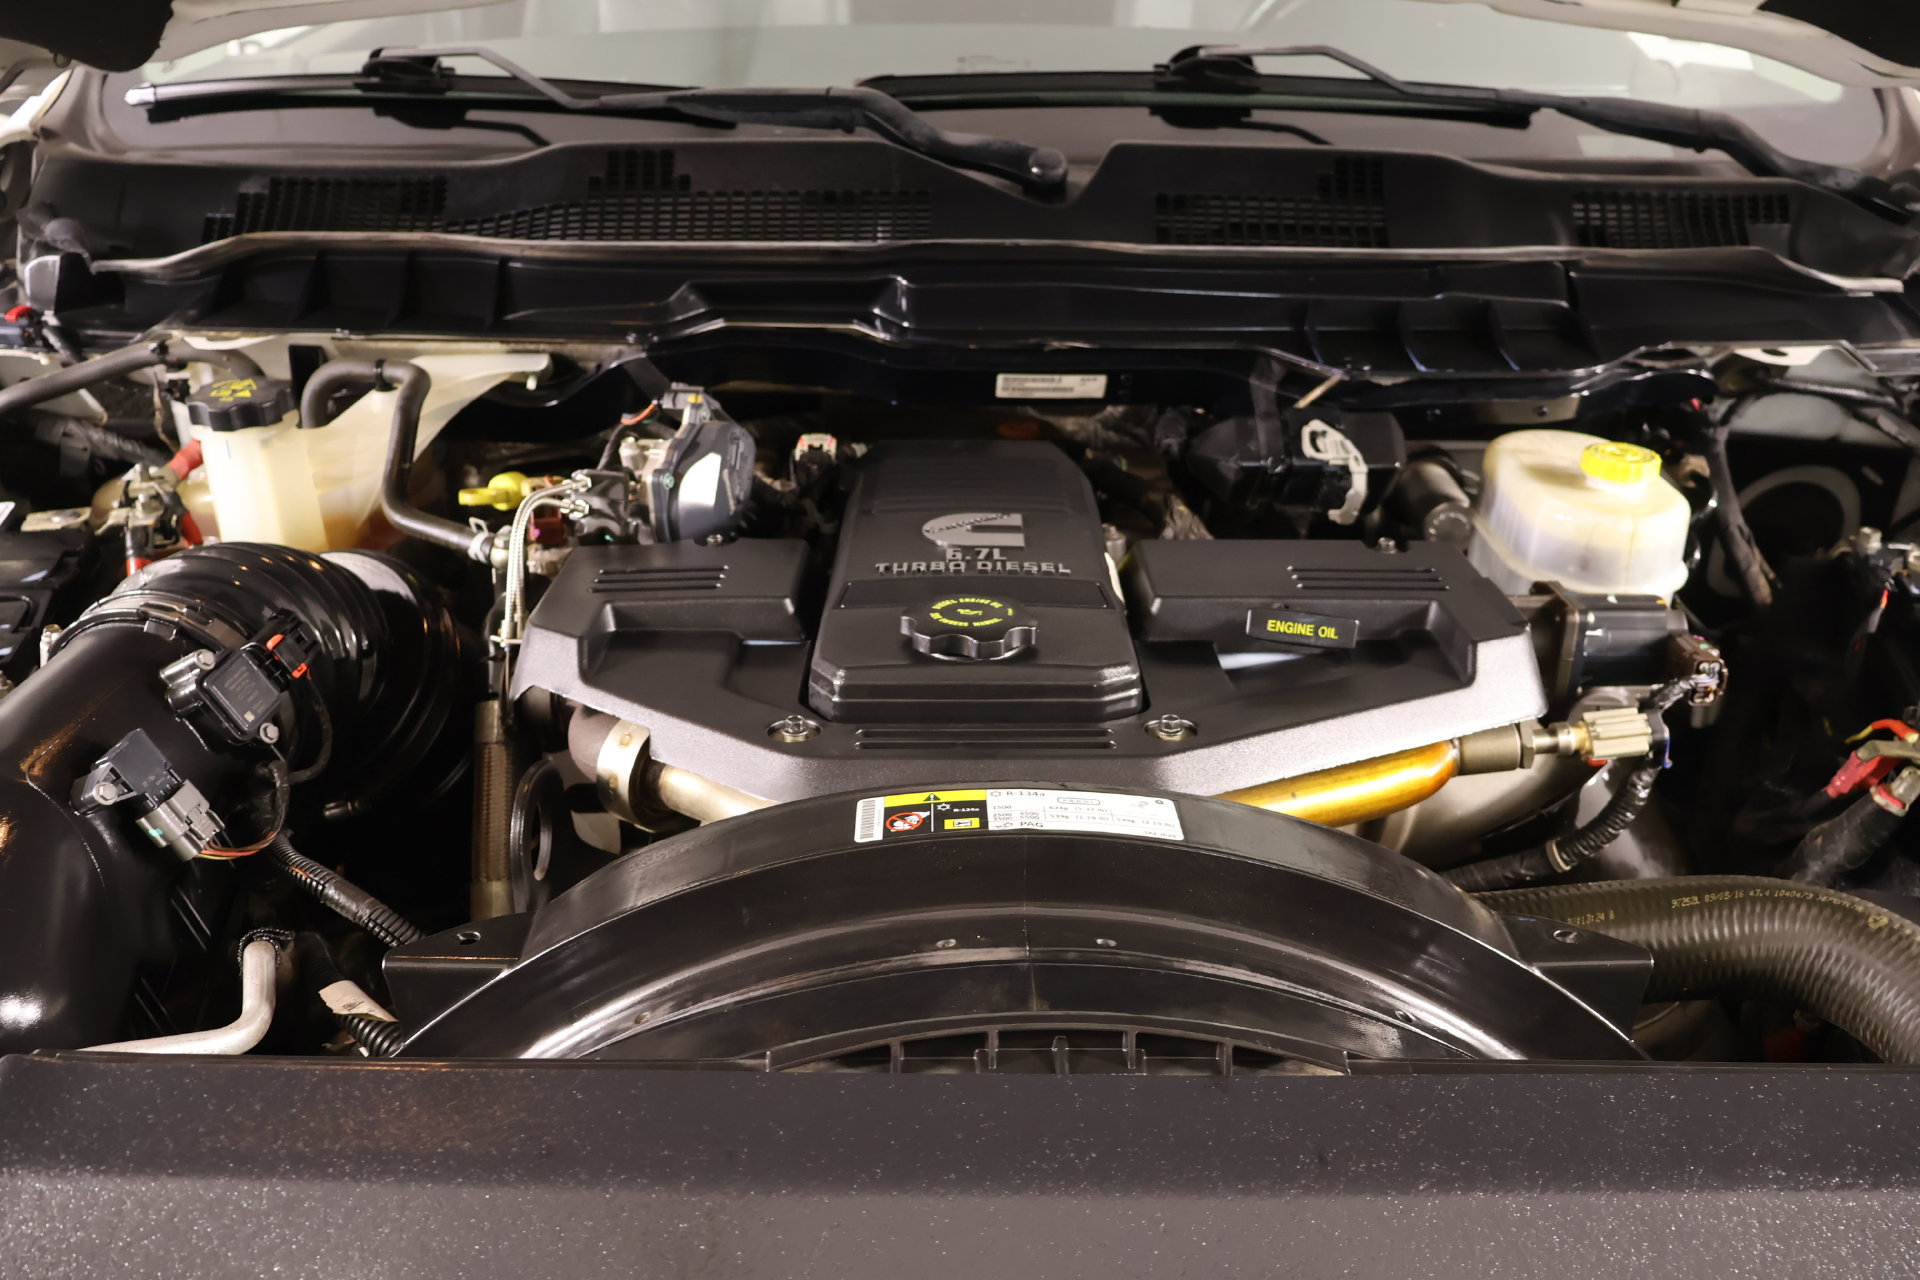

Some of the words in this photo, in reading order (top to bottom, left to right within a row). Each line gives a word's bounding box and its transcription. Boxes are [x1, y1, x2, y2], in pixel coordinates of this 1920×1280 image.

[946, 547, 1007, 561] 6.7L
[875, 559, 966, 576] TURBO
[976, 561, 1072, 576] DIESEL
[1266, 619, 1315, 637] ENGINE
[1317, 625, 1339, 640] OIL
